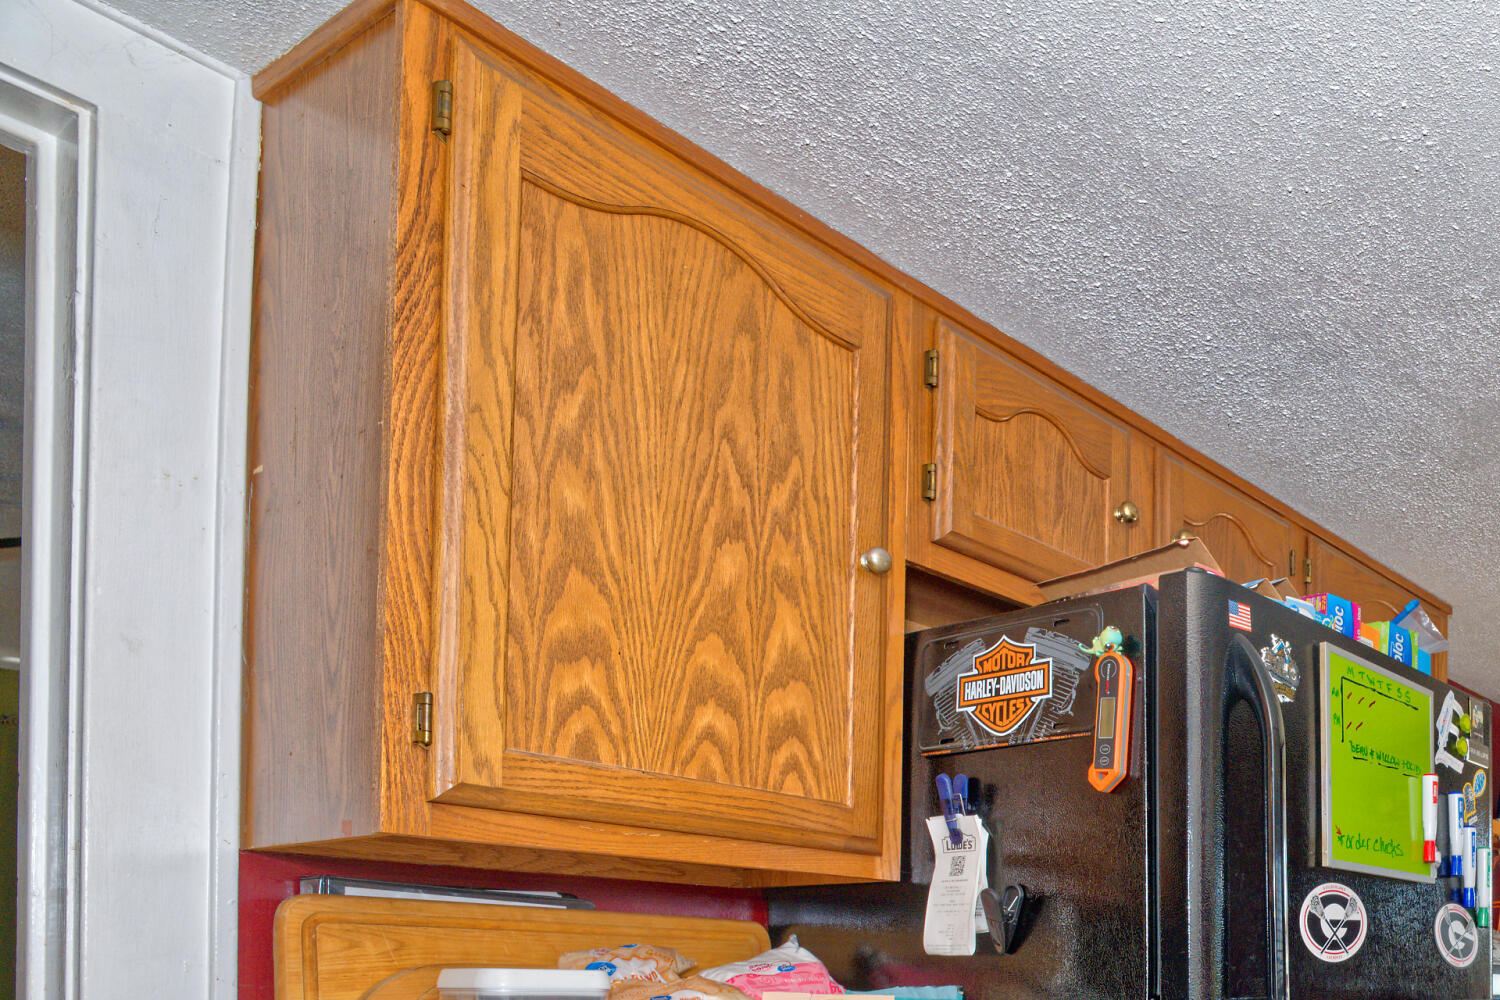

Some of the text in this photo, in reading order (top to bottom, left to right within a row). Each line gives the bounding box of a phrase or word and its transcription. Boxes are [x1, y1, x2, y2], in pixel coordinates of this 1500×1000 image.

[982, 648, 1026, 673] MOTOR
[964, 669, 1044, 700] HARLEY-DAVIDSON
[981, 697, 1025, 726] CYCLES
